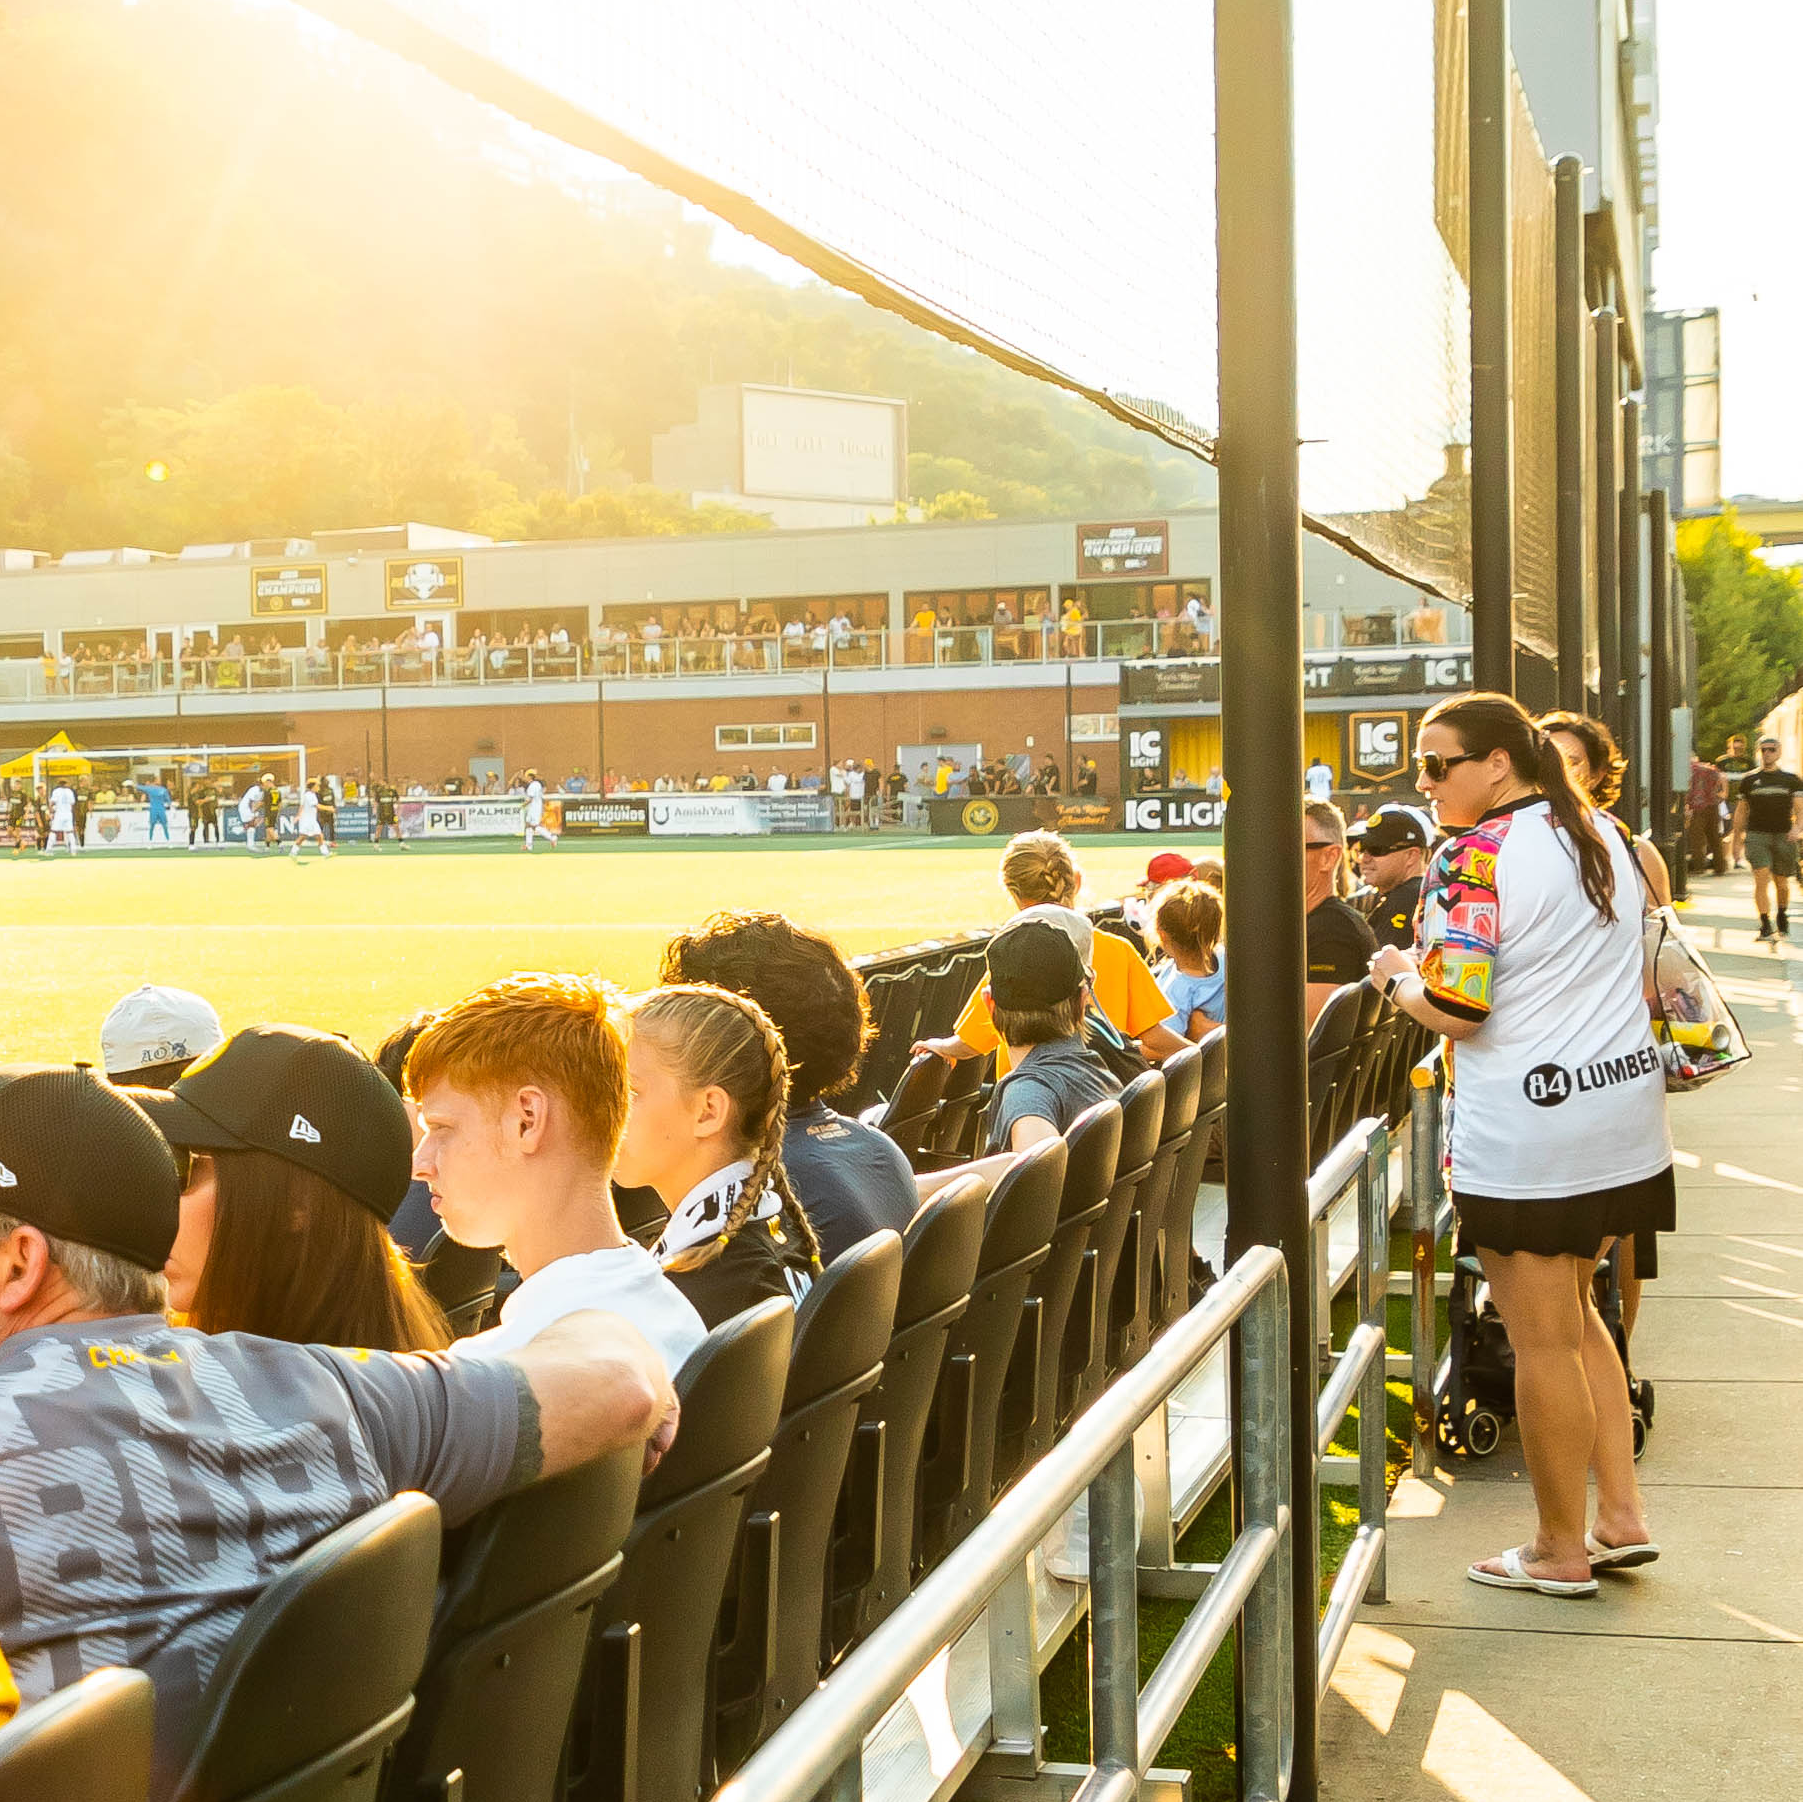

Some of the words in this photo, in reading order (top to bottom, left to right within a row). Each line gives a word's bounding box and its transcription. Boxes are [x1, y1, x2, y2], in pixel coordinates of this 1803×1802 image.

[1424, 659, 1458, 686] IC
[1129, 731, 1161, 758] IC
[1359, 721, 1398, 754] IC
[1129, 757, 1160, 767] LIGHT
[1359, 753, 1398, 767] LIGHT
[430, 812, 464, 827] PPI
[468, 804, 521, 816] PALMER
[565, 809, 646, 822] RIVERHOUNDS
[1125, 799, 1161, 830] IC
[1528, 1069, 1569, 1100] 84
[1576, 1045, 1661, 1093] LUMBER
